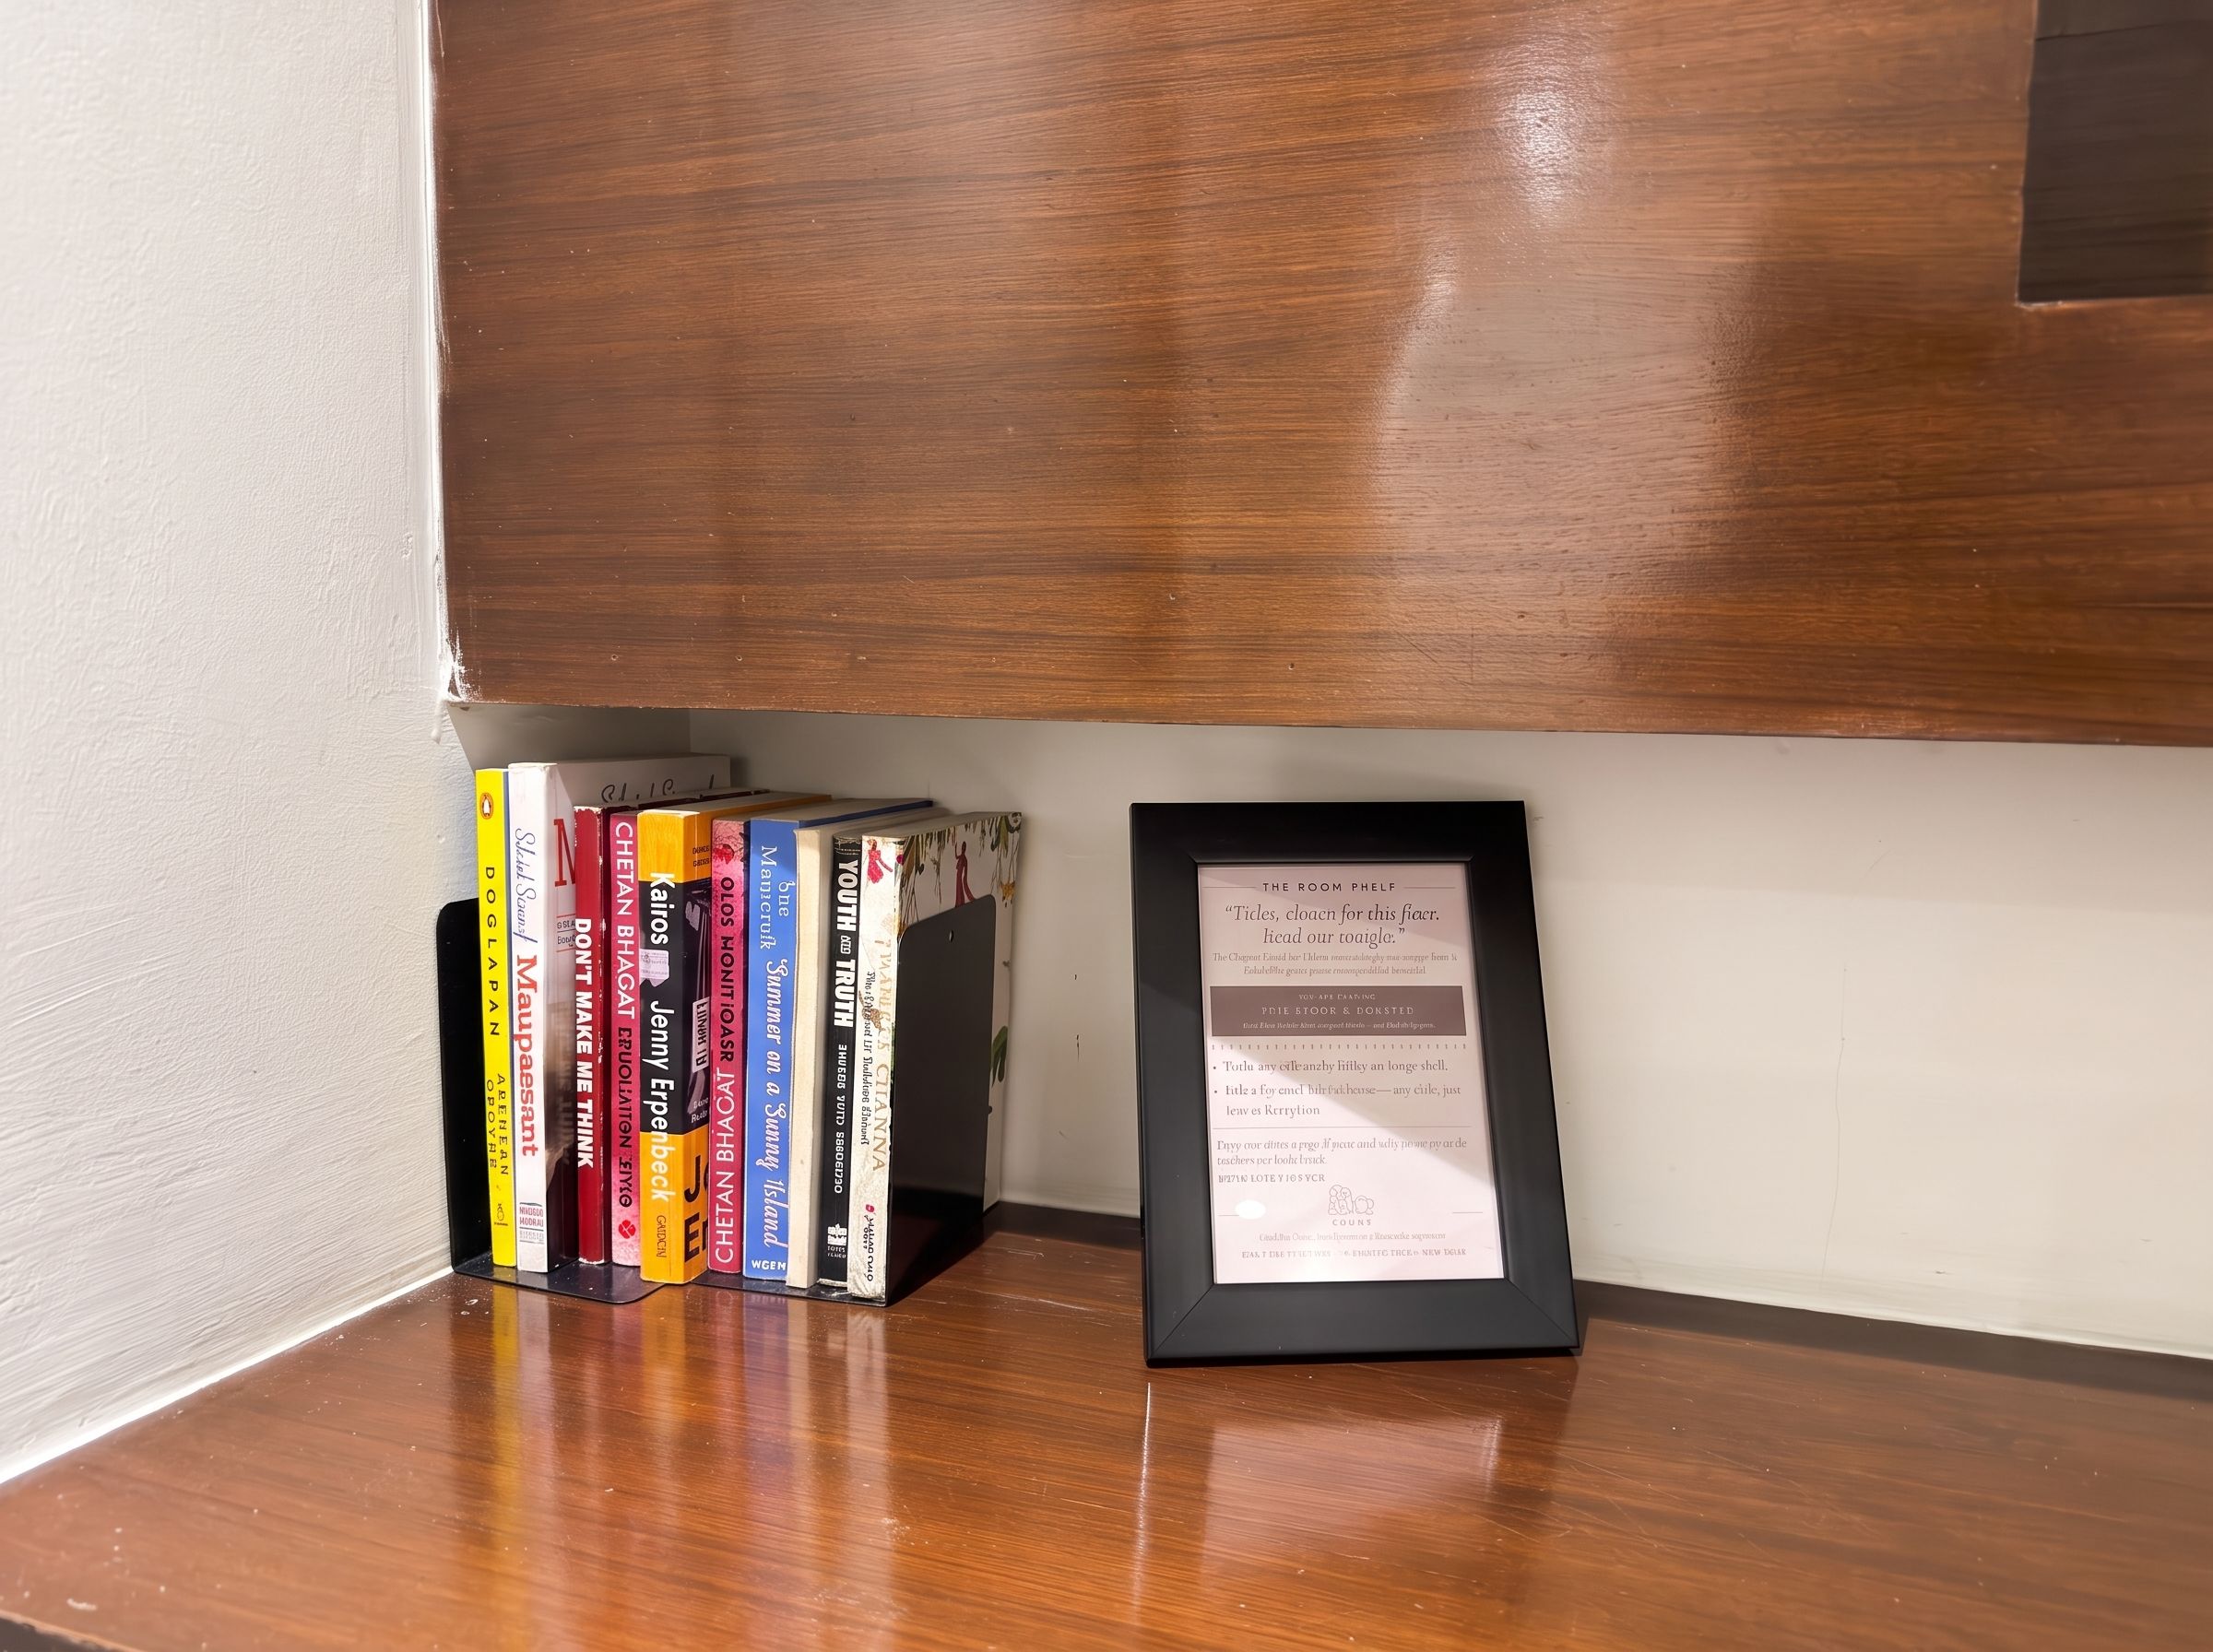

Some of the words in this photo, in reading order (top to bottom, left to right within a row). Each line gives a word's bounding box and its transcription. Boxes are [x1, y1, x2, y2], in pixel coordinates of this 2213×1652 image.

[615, 821, 634, 915] CHETAN
[719, 876, 736, 927] OLOS
[836, 859, 858, 932] YOUTH
[1262, 882, 1289, 891] THE
[1297, 882, 1343, 892] ROOM
[1351, 882, 1396, 892] PHELF
[649, 872, 676, 946] Kairos
[1307, 931, 1334, 944] our
[1339, 903, 1364, 925] for
[1367, 904, 1396, 921] this
[483, 867, 500, 1036] DOGLAPAN
[574, 918, 593, 985] DON'T
[617, 925, 635, 1021] BHAGAT
[575, 991, 594, 1055] MAKE
[764, 958, 788, 1046] Summer
[833, 959, 856, 1028] TRUTH
[1343, 1007, 1351, 1015] &
[642, 1000, 676, 1071] Jenny
[766, 1053, 781, 1075] on
[1370, 1063, 1385, 1071] an
[576, 1059, 594, 1093] ME
[766, 1082, 781, 1097] a
[1250, 1088, 1258, 1096] a
[1393, 1088, 1412, 1100] any
[1441, 1085, 1462, 1098] just
[576, 1098, 595, 1169] THINK
[643, 1078, 677, 1203] Erpenbeck
[755, 1103, 787, 1172] Sunny
[715, 1171, 735, 1264] CHETAN
